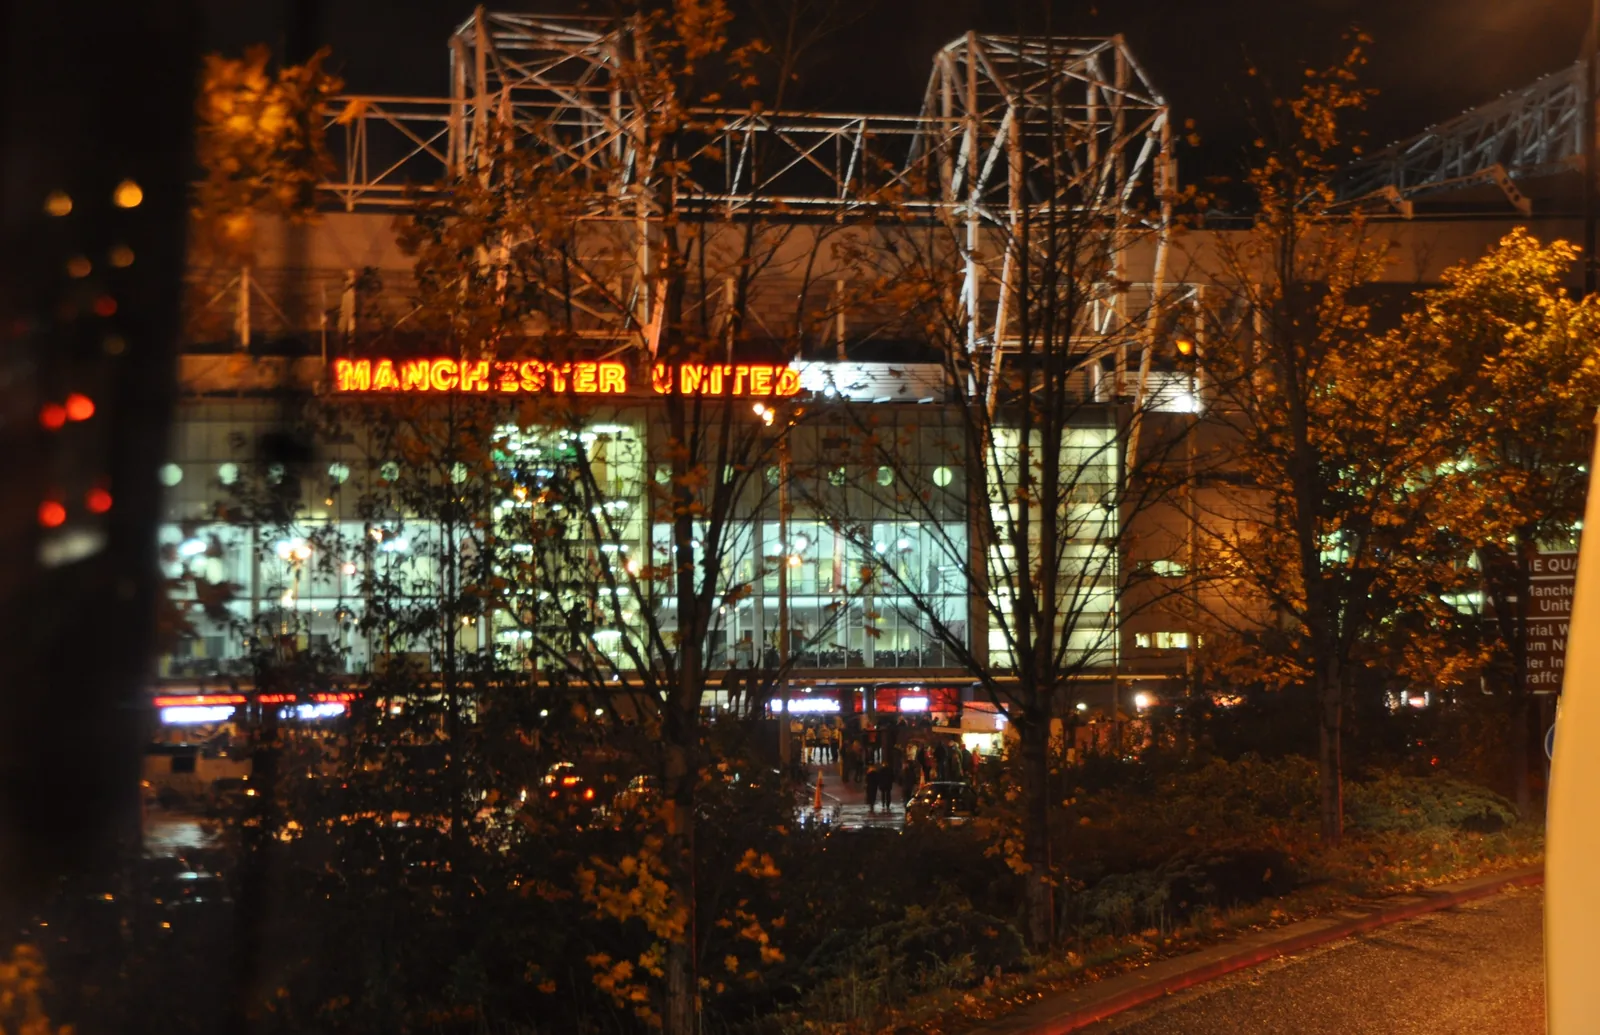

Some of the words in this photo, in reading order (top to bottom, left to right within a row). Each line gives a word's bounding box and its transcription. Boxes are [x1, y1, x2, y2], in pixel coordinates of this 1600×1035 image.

[336, 358, 626, 393] MANCHESTER
[652, 362, 801, 396] UNITED
[1540, 599, 1571, 612] Unit
[1552, 638, 1567, 651] N
